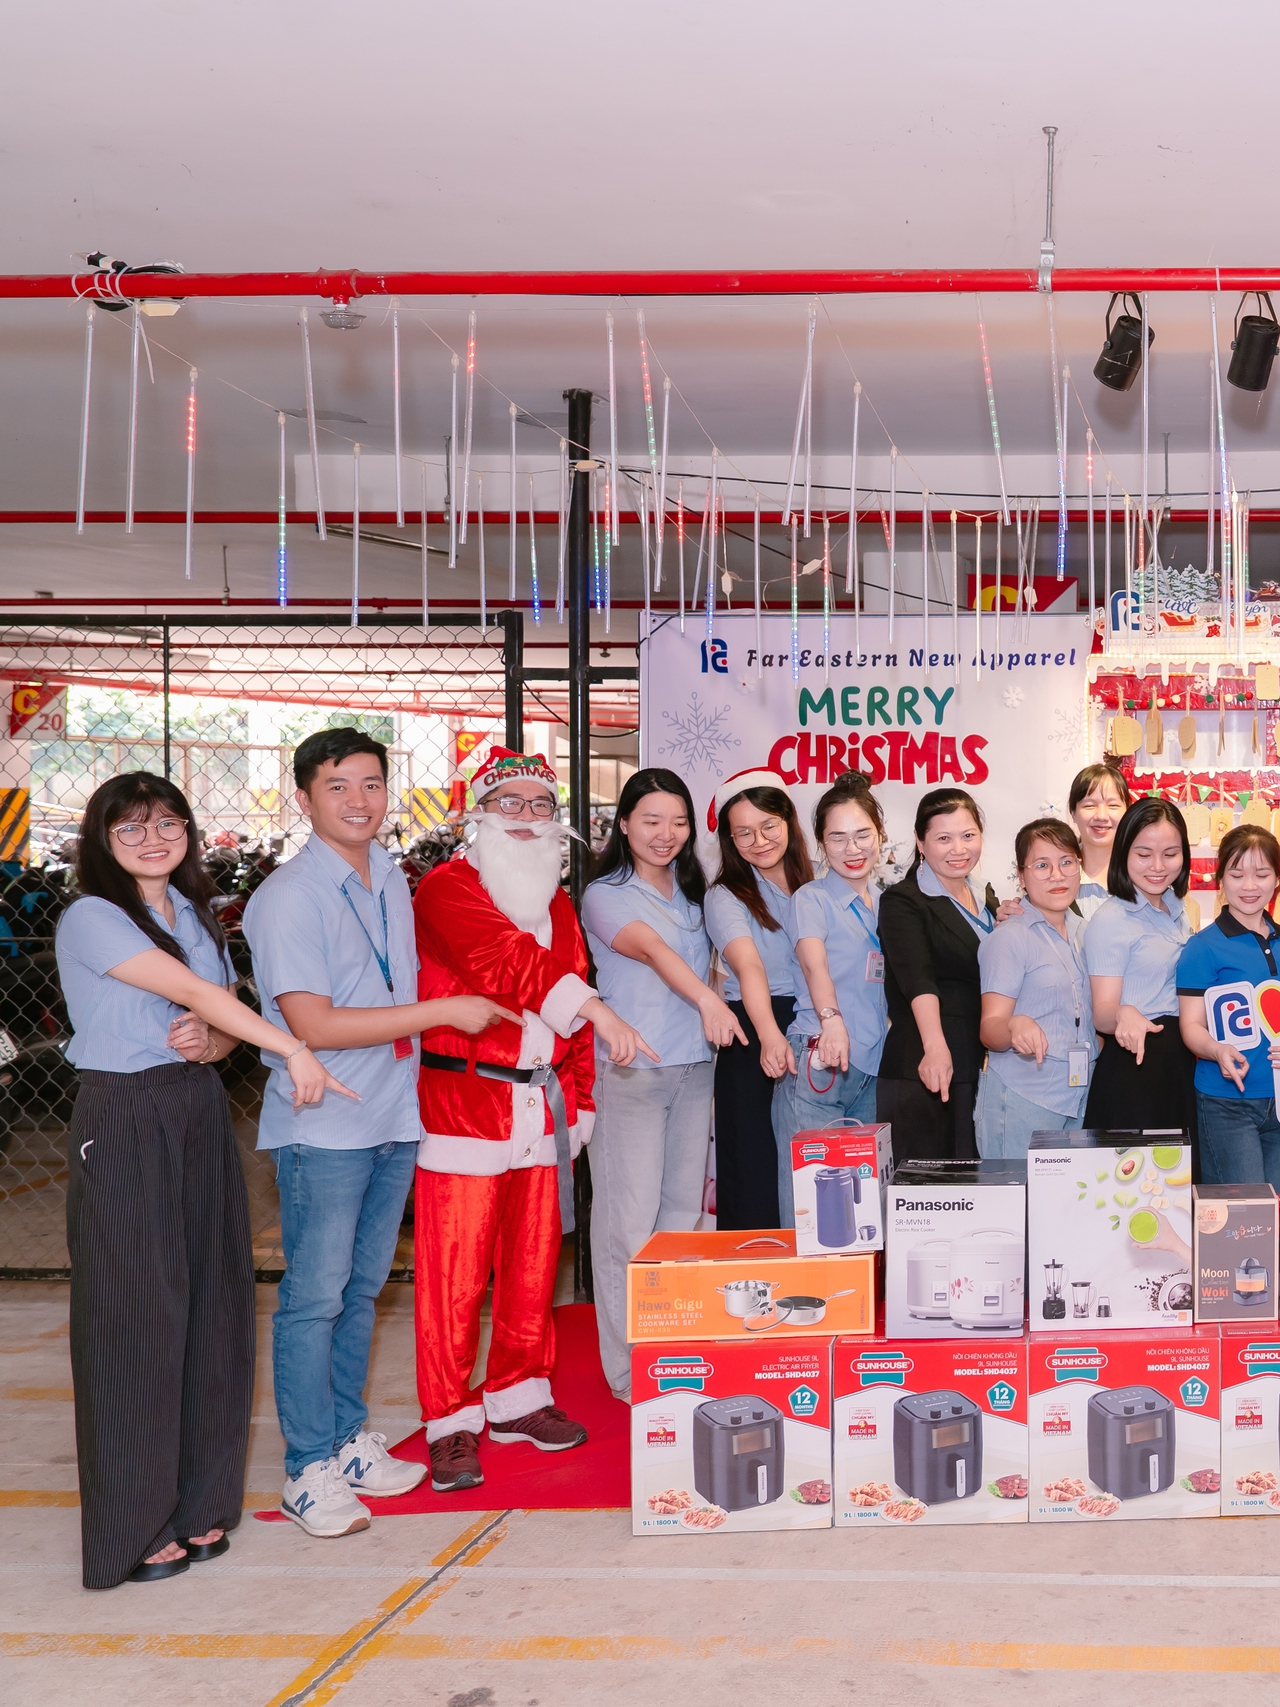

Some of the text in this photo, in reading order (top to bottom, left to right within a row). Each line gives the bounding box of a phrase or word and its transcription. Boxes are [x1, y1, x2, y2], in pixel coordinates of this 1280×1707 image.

[747, 648, 1076, 671] Far Eastern New Apparel
[14, 688, 40, 715] C
[799, 686, 955, 727] MERRY
[37, 713, 62, 731] 20
[457, 733, 476, 752] C
[861, 1166, 869, 1174] 12
[895, 1198, 974, 1211] Panasonic
[895, 1218, 931, 1226] SR-MVN18
[1201, 1268, 1230, 1278] Moon
[1201, 1287, 1229, 1297] Woki
[637, 1298, 703, 1312] Hawo Gigu
[638, 1313, 678, 1321] STAINLESS
[857, 1362, 908, 1370] SUNHOUSE
[1052, 1358, 1102, 1366] SUNHOUSE
[654, 1367, 707, 1375] SUNHOUSE
[993, 1387, 1008, 1400] 12
[1186, 1383, 1201, 1395] 12
[795, 1392, 811, 1404] 12
